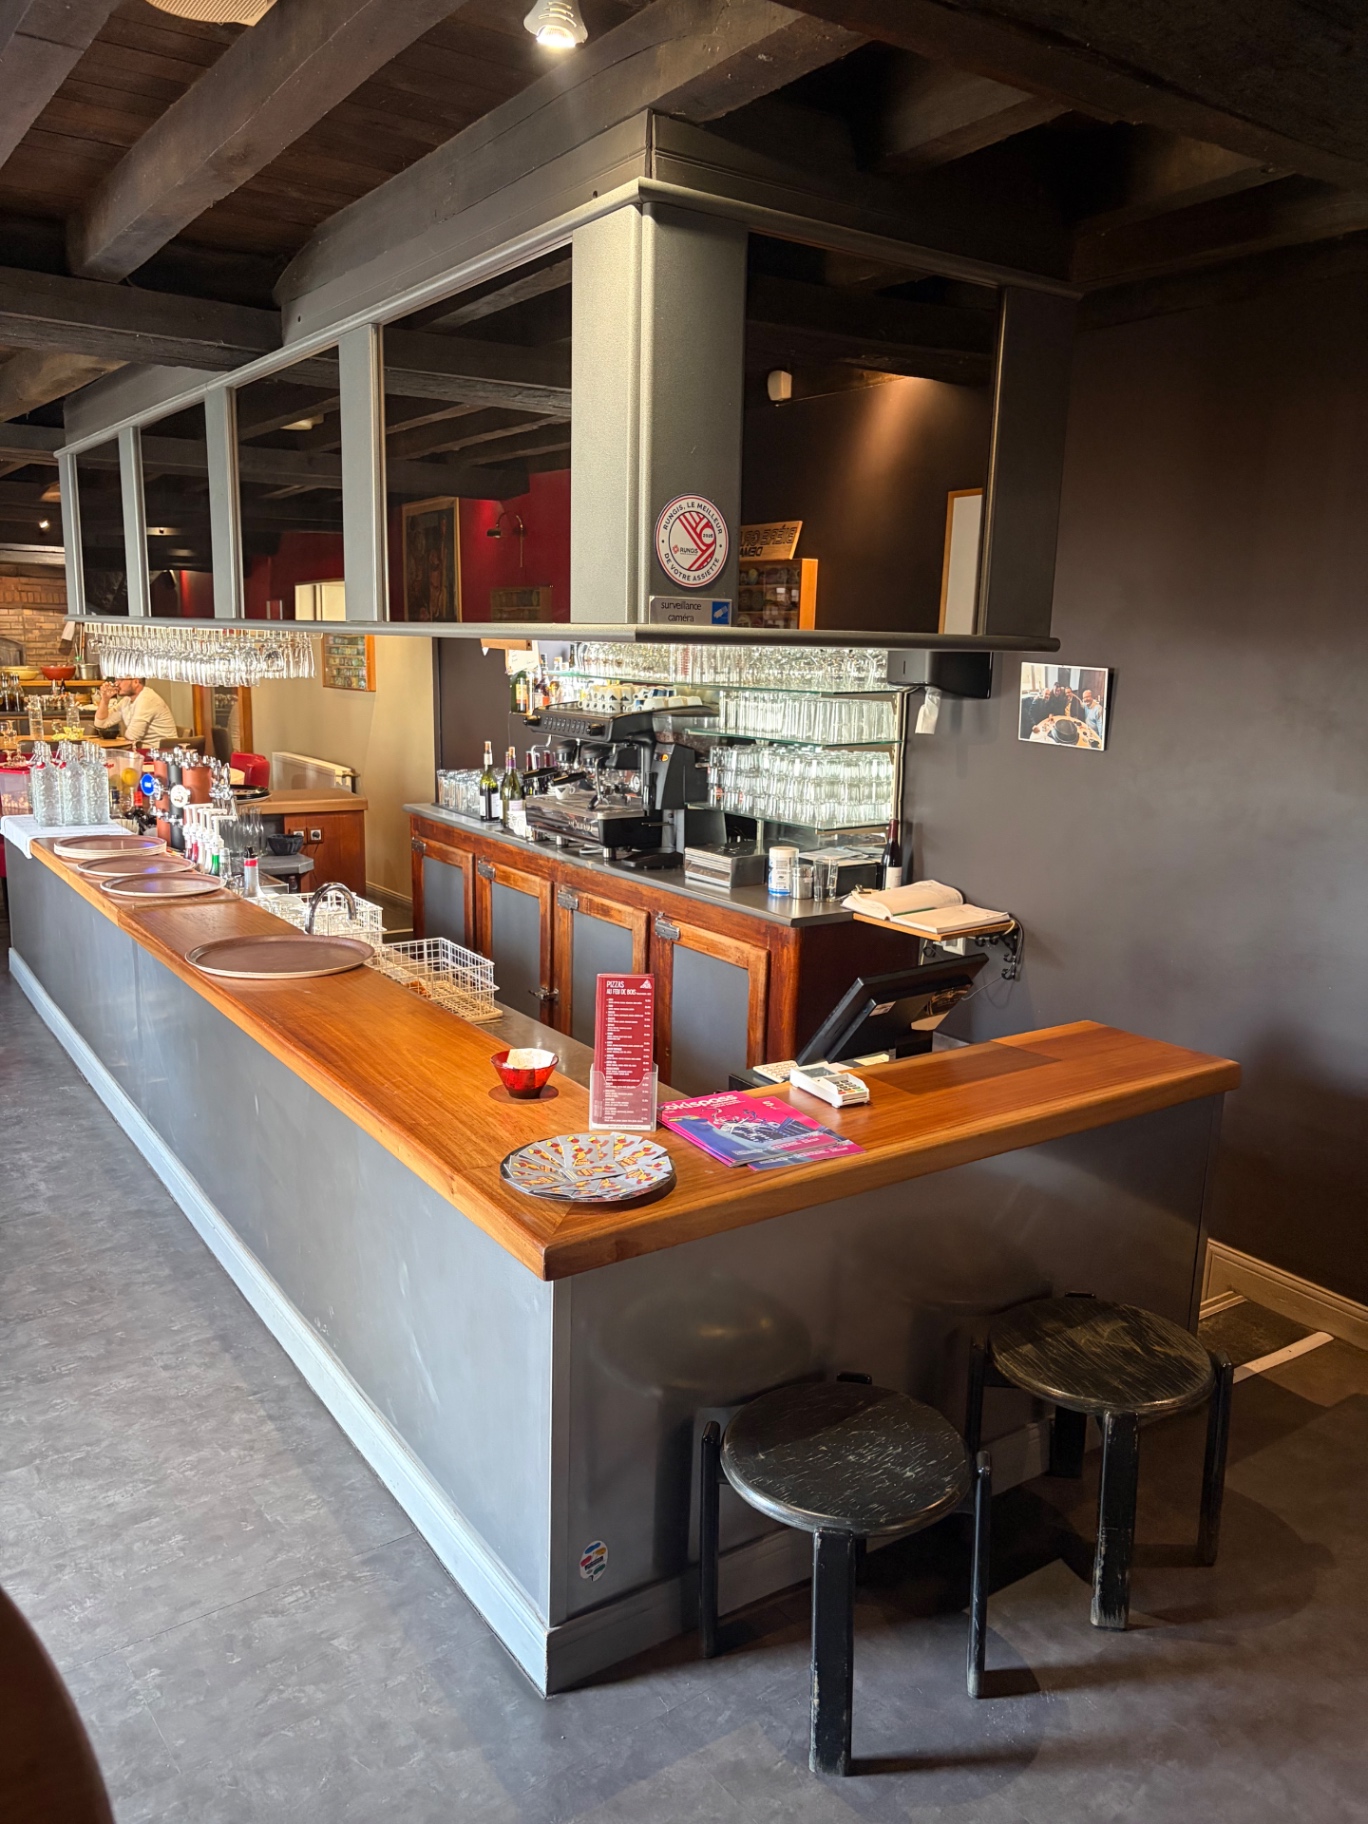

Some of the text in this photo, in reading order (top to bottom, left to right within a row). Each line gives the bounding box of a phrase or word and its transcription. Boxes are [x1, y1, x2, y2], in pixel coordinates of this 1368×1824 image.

[663, 505, 686, 530] RUNGIS,
[697, 502, 723, 535] MEILLEUR
[664, 553, 720, 582] DE VOTRE ASSIETTE
[661, 600, 702, 611] surveillance
[668, 613, 694, 622] caméra
[606, 980, 625, 988] PIZZAS
